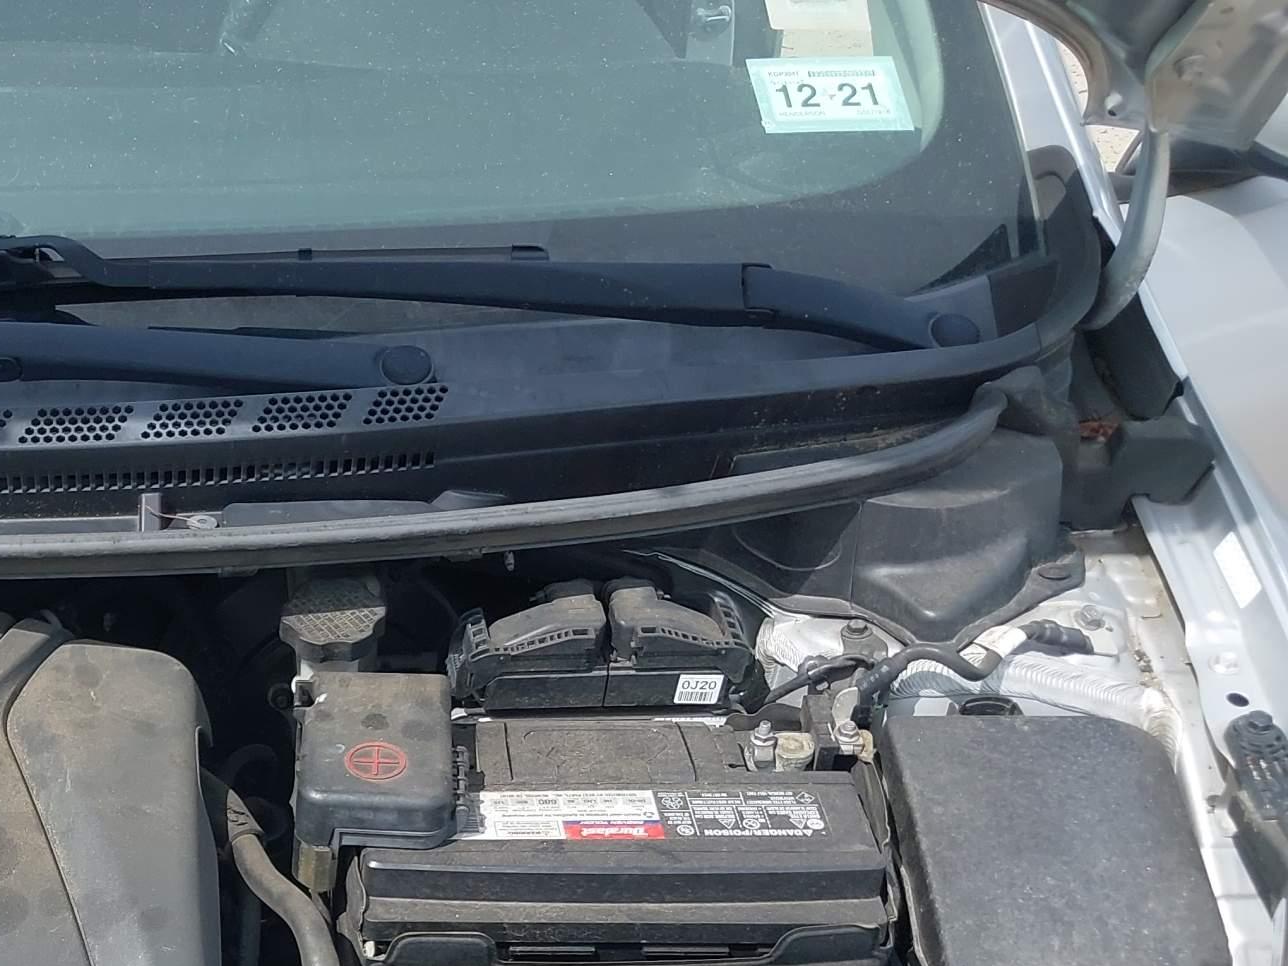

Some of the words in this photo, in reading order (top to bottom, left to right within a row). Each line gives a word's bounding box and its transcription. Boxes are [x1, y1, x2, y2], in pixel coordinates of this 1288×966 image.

[775, 82, 821, 108] 12
[837, 82, 879, 107] 21
[580, 827, 649, 837] Duralast
